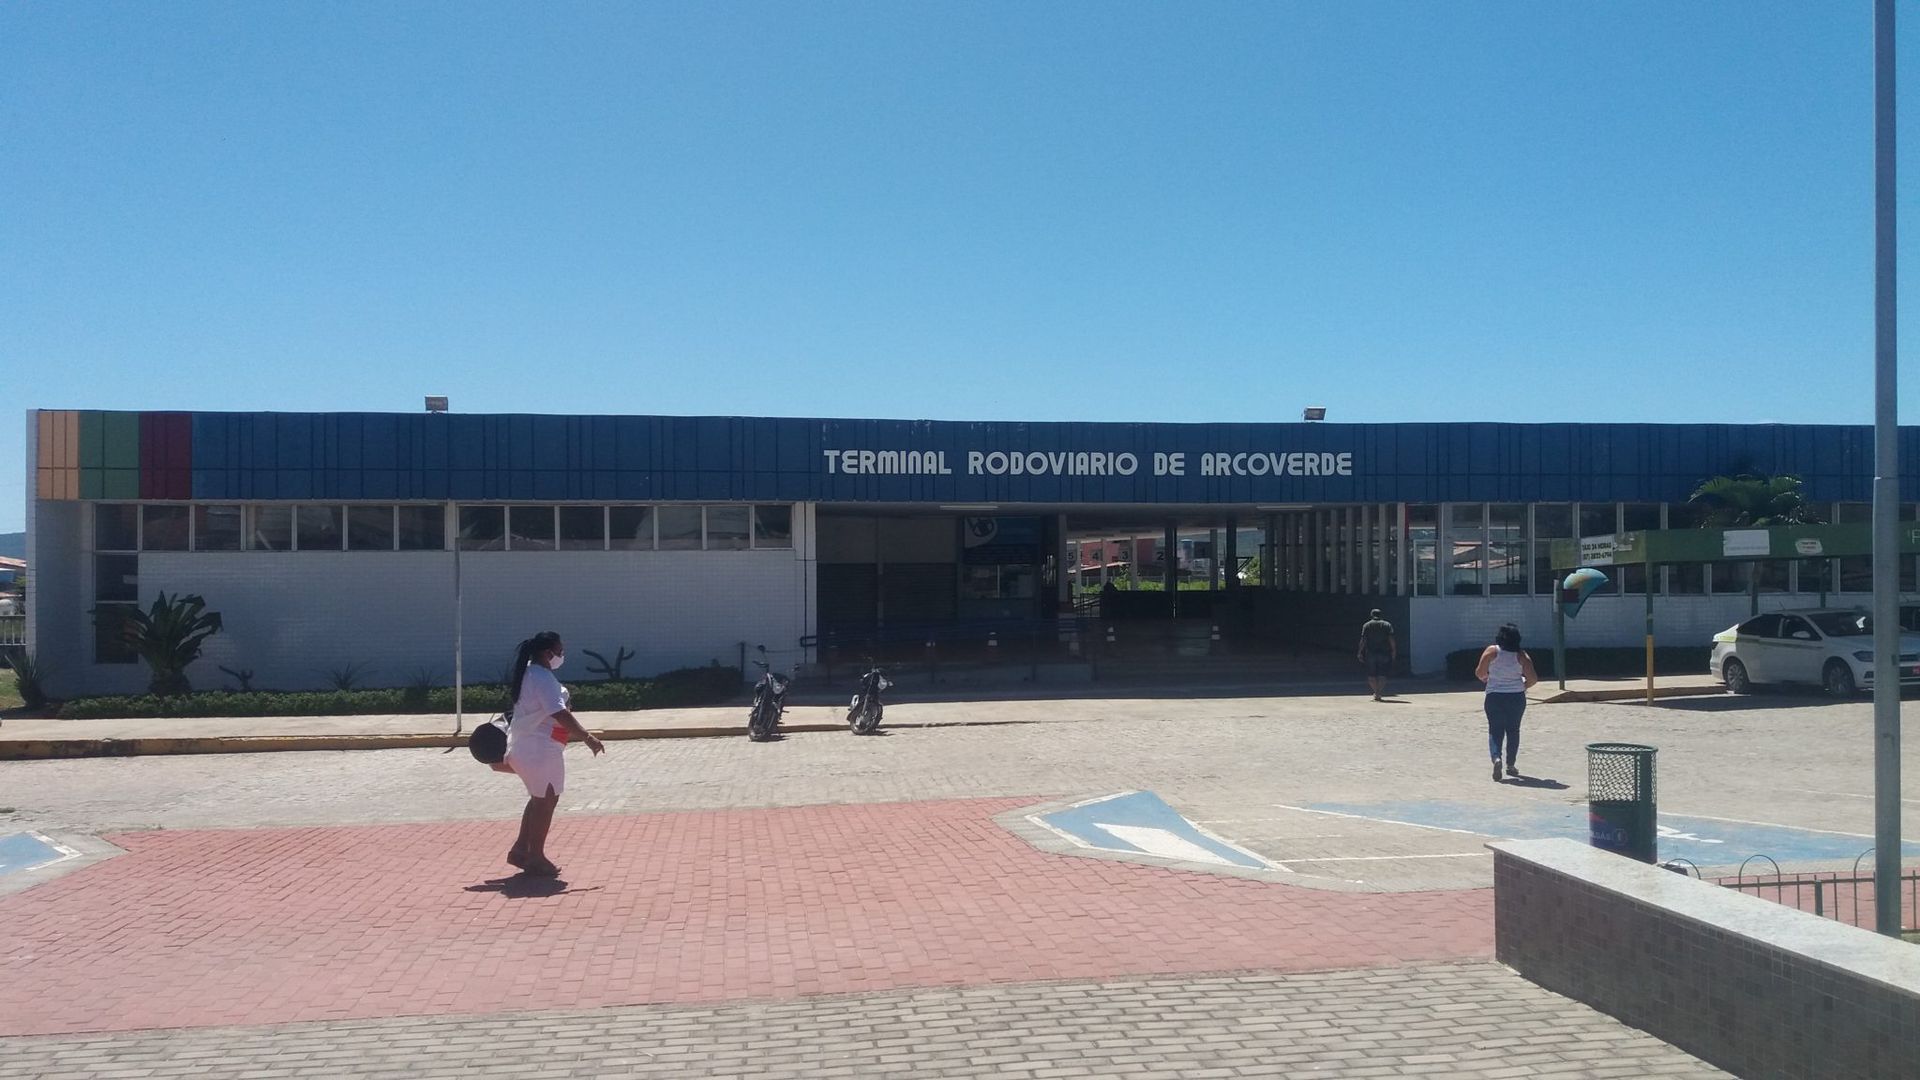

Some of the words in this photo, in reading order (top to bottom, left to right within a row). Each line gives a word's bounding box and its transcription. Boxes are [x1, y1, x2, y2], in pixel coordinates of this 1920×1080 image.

[824, 450, 951, 475] TERMINAL
[1154, 452, 1184, 476] DE
[1201, 452, 1352, 476] ARCOVERDE
